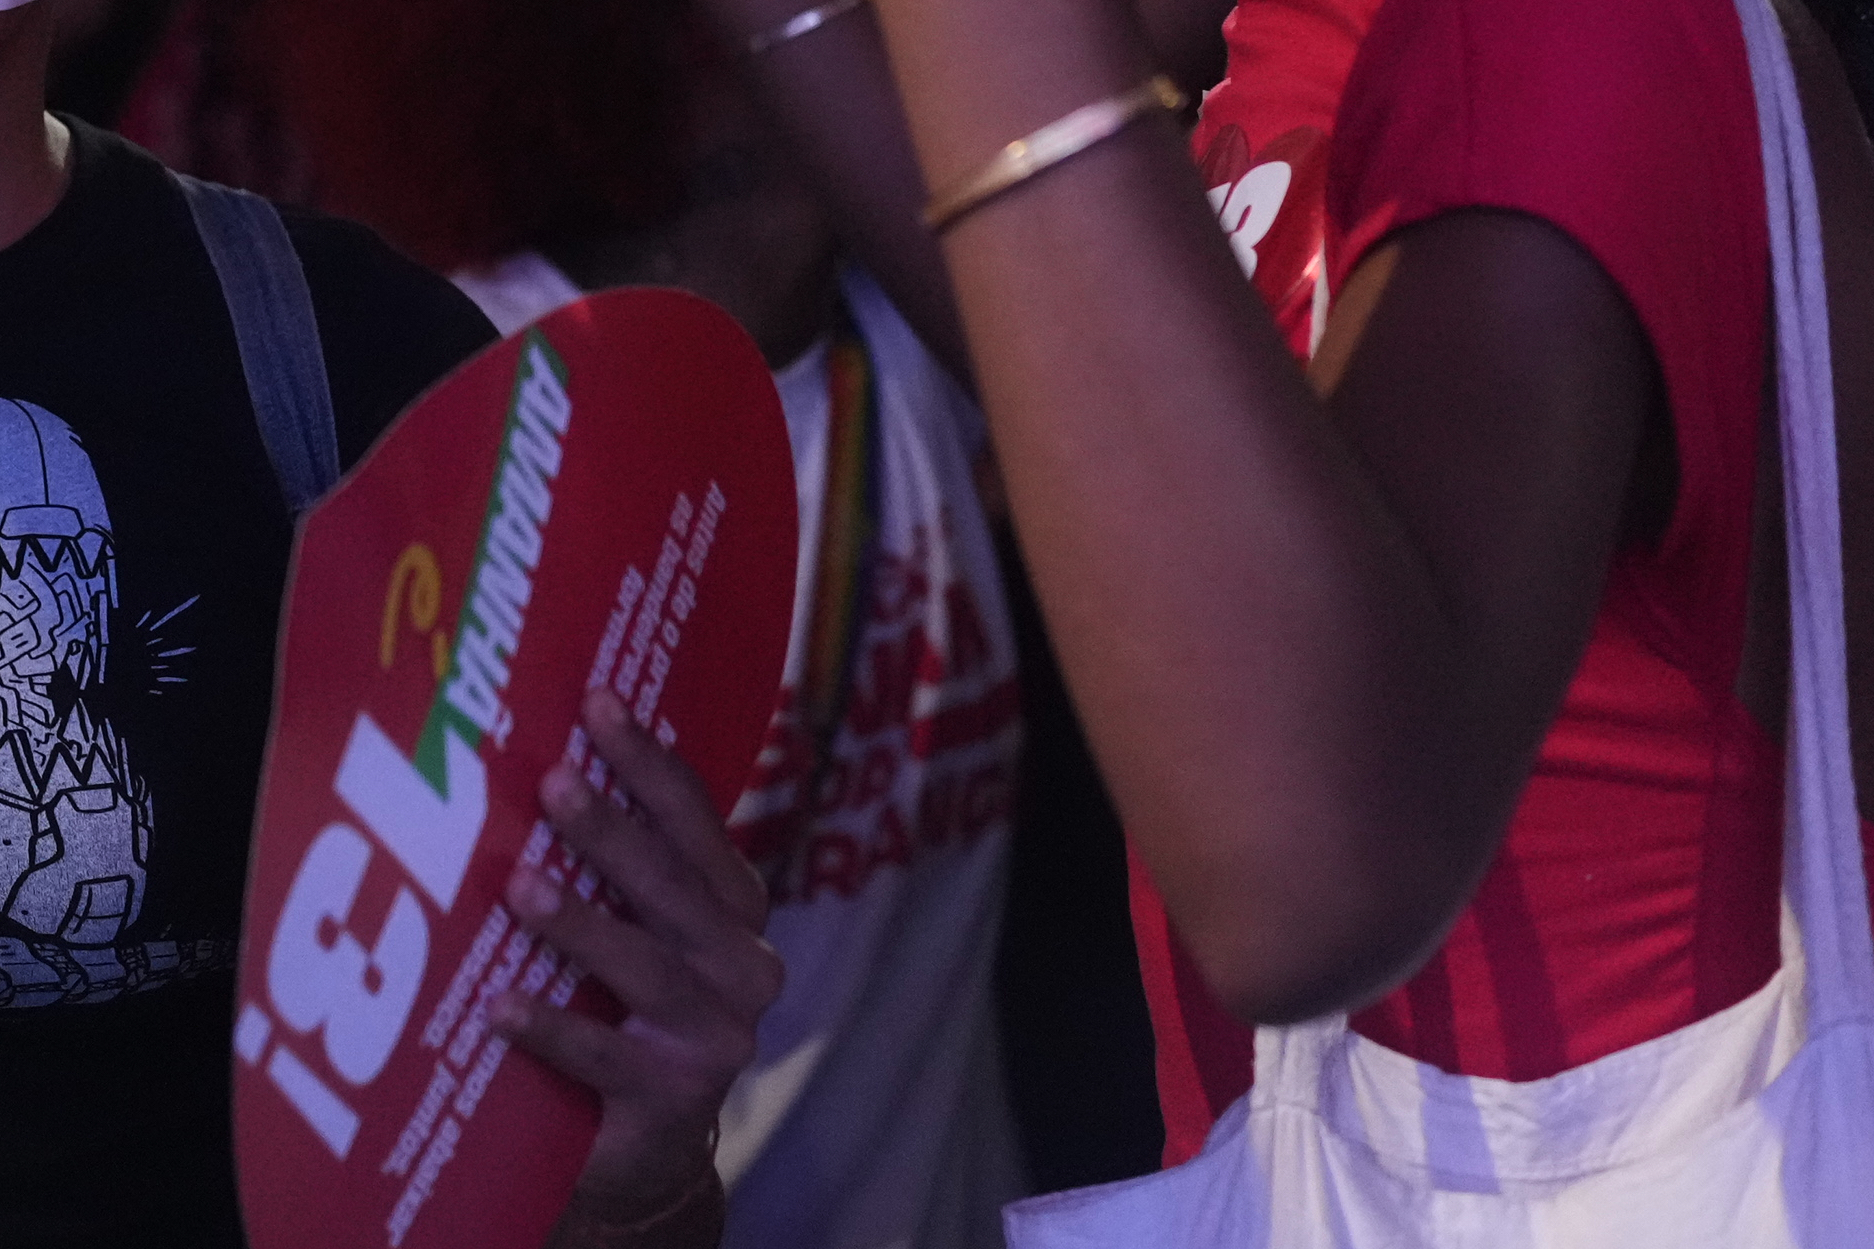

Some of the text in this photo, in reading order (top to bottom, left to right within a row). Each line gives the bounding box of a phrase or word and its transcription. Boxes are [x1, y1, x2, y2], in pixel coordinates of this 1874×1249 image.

[442, 342, 572, 748] AMANHÃ
[616, 537, 682, 699] bandeiras
[687, 482, 726, 575] Antes
[235, 713, 489, 1158] 13!
